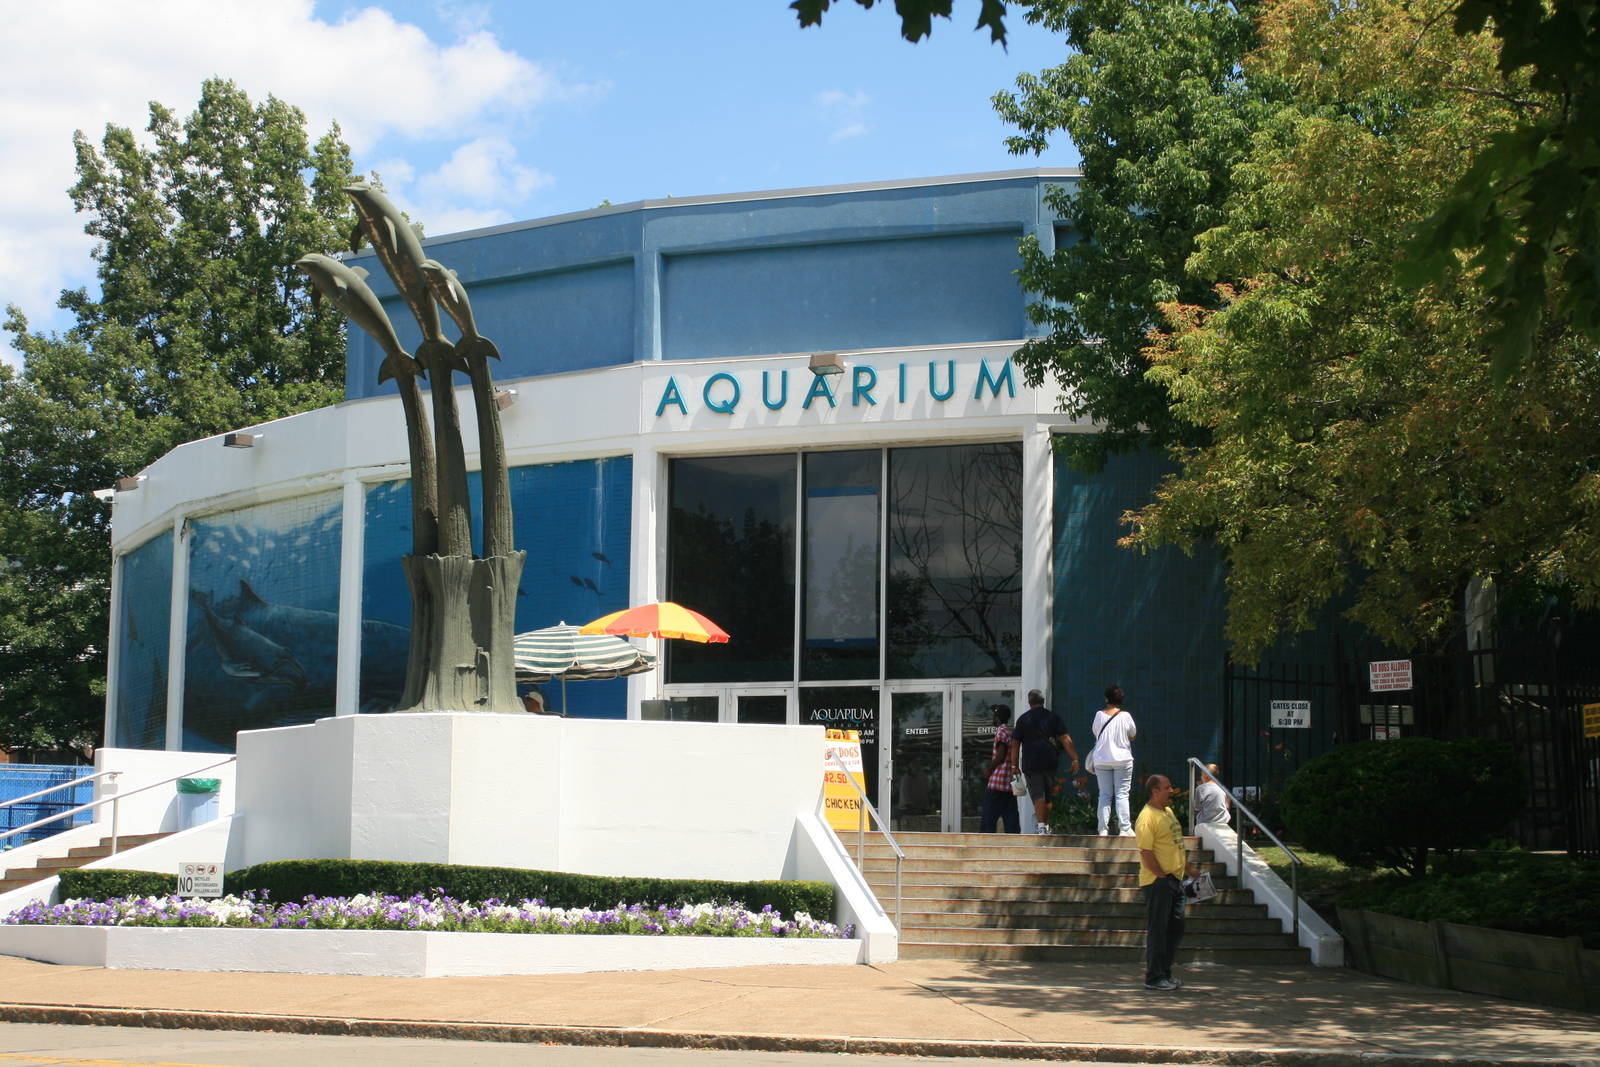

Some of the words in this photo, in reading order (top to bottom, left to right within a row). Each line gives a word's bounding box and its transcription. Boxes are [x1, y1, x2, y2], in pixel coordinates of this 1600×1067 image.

[655, 356, 1016, 417] AQUARIUM
[1378, 662, 1390, 672] DOGS
[1390, 661, 1410, 671] ALLOWED
[1272, 702, 1290, 710] GATES
[1291, 702, 1309, 710] CLOSE
[810, 708, 874, 722] AQUARIUM
[1287, 710, 1295, 718] AT
[1293, 718, 1303, 726] PM
[838, 746, 859, 758] DOGS
[825, 797, 860, 810] CHICKEN
[180, 876, 193, 893] NO
